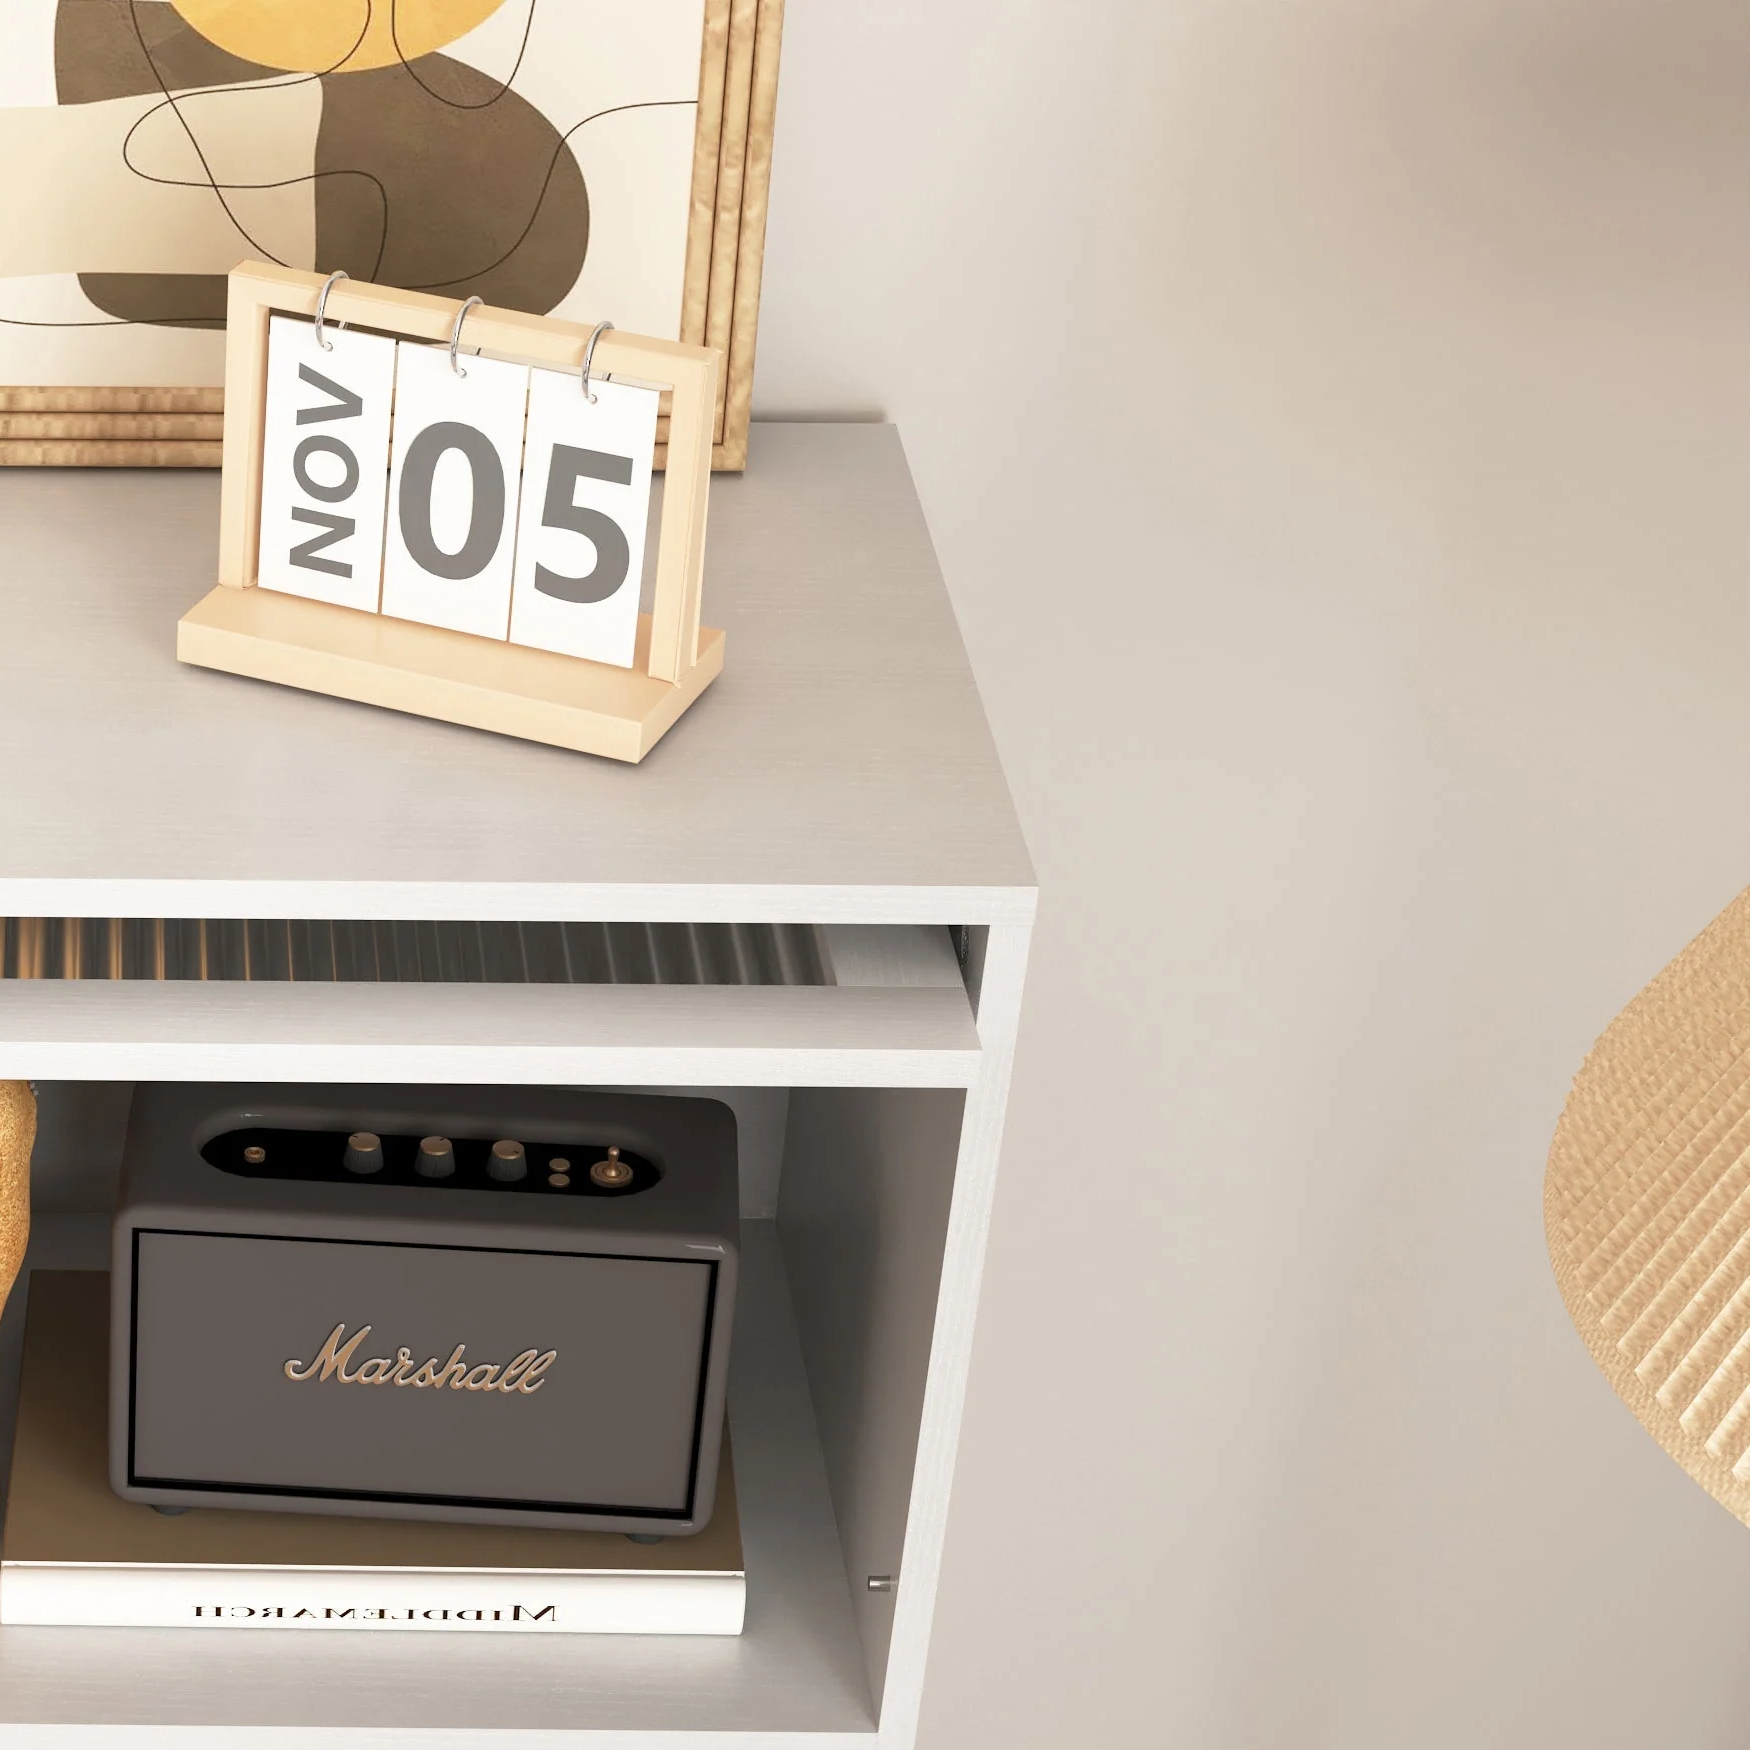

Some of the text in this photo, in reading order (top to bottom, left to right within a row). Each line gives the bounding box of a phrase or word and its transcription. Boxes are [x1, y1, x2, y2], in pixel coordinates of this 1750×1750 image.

[289, 362, 364, 579] NOV
[398, 421, 634, 604] 05
[283, 1323, 559, 1394] Marshall
